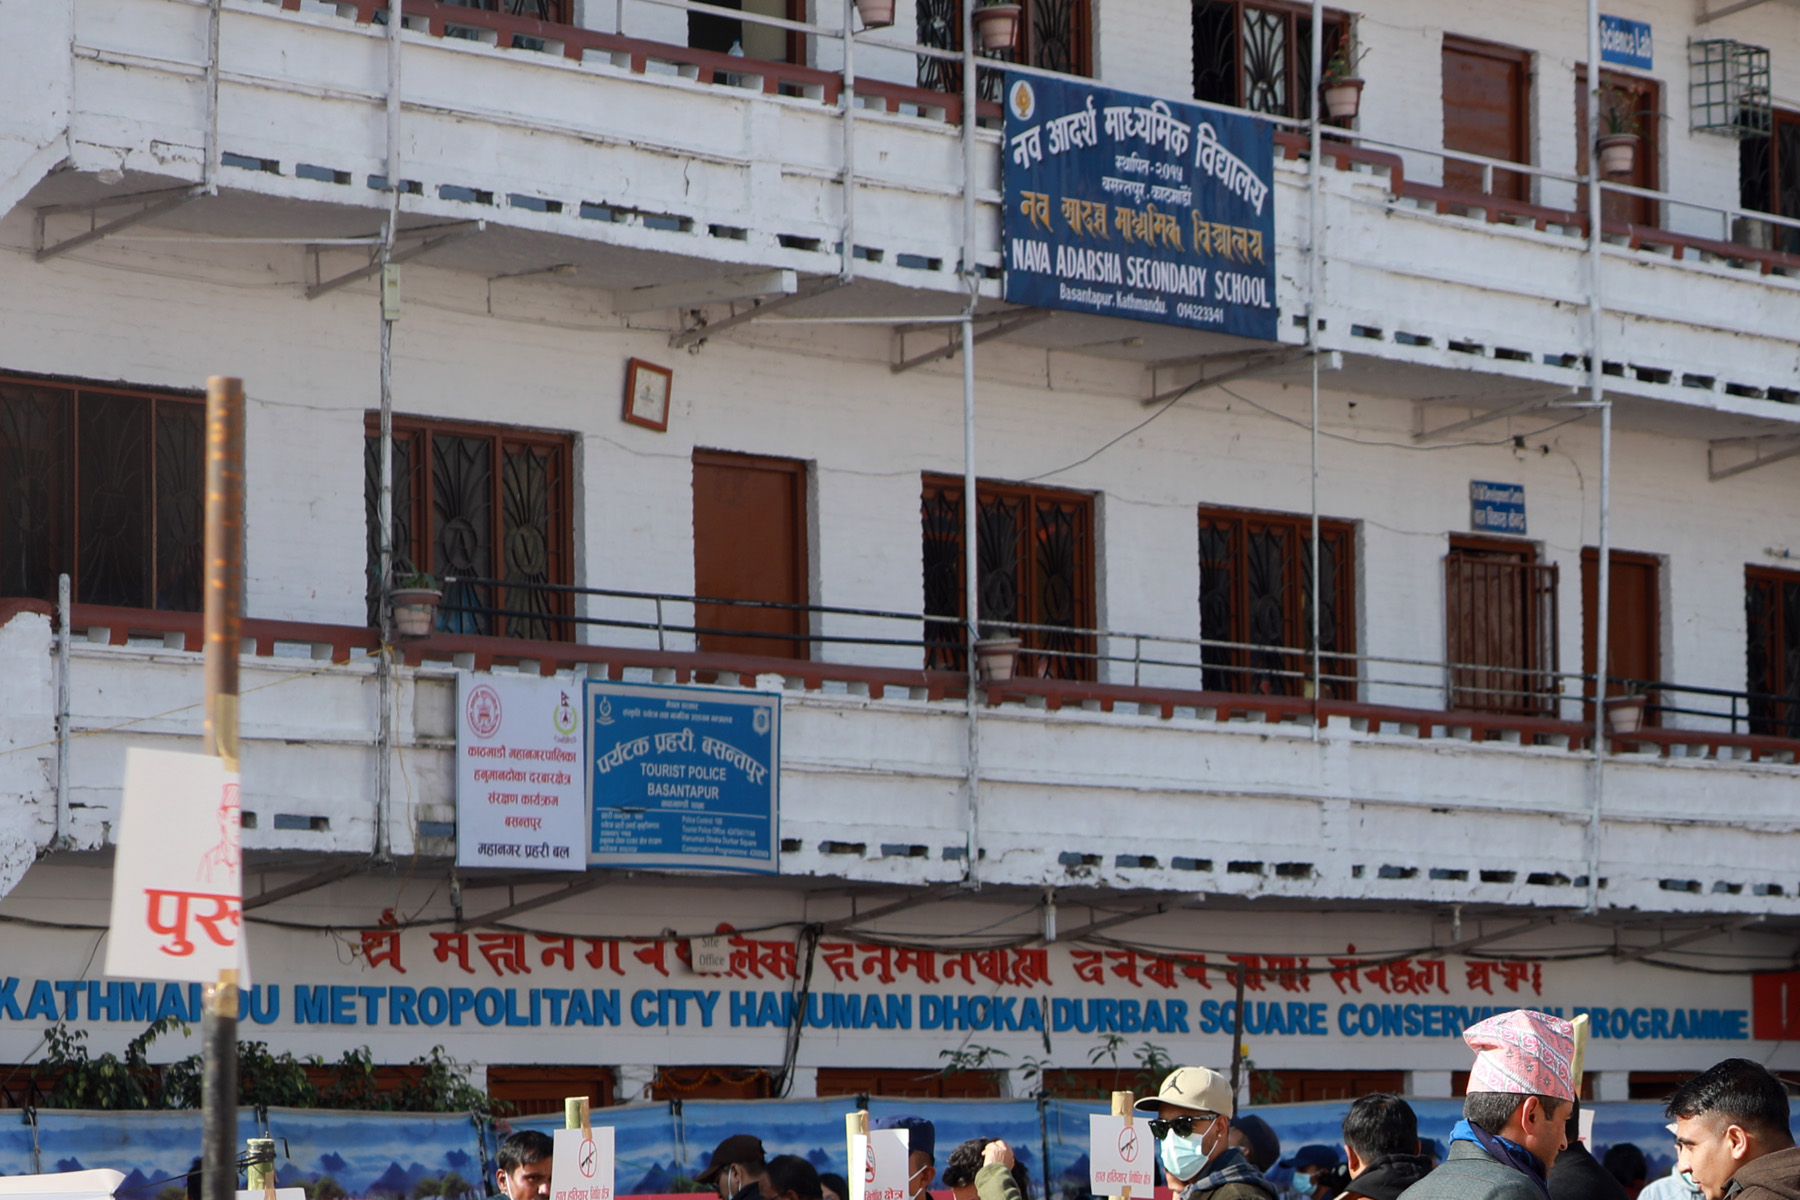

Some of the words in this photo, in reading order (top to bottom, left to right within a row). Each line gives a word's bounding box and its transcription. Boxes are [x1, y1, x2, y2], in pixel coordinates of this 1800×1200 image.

[1600, 20, 1634, 56] Science
[1635, 28, 1651, 58] Lab
[1011, 125, 1042, 169] नव
[1047, 96, 1098, 155] आदर्श
[1104, 101, 1191, 156] माध्यमिक
[1195, 122, 1268, 216] विद्यालय
[1012, 238, 1051, 274] NAVA
[1056, 245, 1122, 285] ADARSHA
[1126, 257, 1207, 297] SECONDARY
[1215, 271, 1271, 309] SCHOOL
[509, 747, 576, 762] महानगरपालिका
[596, 735, 650, 773] पर्यटक
[702, 736, 768, 786] बसन्तपुर
[640, 763, 686, 778] TOURIST
[688, 765, 726, 781] POLICE
[647, 783, 719, 799] BASANTAPUR
[478, 842, 521, 857] महानगर
[525, 842, 549, 859] प्रहरी
[553, 845, 569, 859] बल
[143, 888, 243, 957] पुरु
[702, 937, 719, 948] Site
[699, 955, 725, 966] Office
[0, 976, 280, 1024] KATHMAU
[294, 985, 620, 1027] METROPOLITAN
[630, 988, 721, 1028] CITY
[730, 991, 912, 1030] HANUMAN
[919, 993, 1046, 1033] DHOKA
[1052, 997, 1190, 1033] DURBAR
[1200, 999, 1329, 1038] SQUARE
